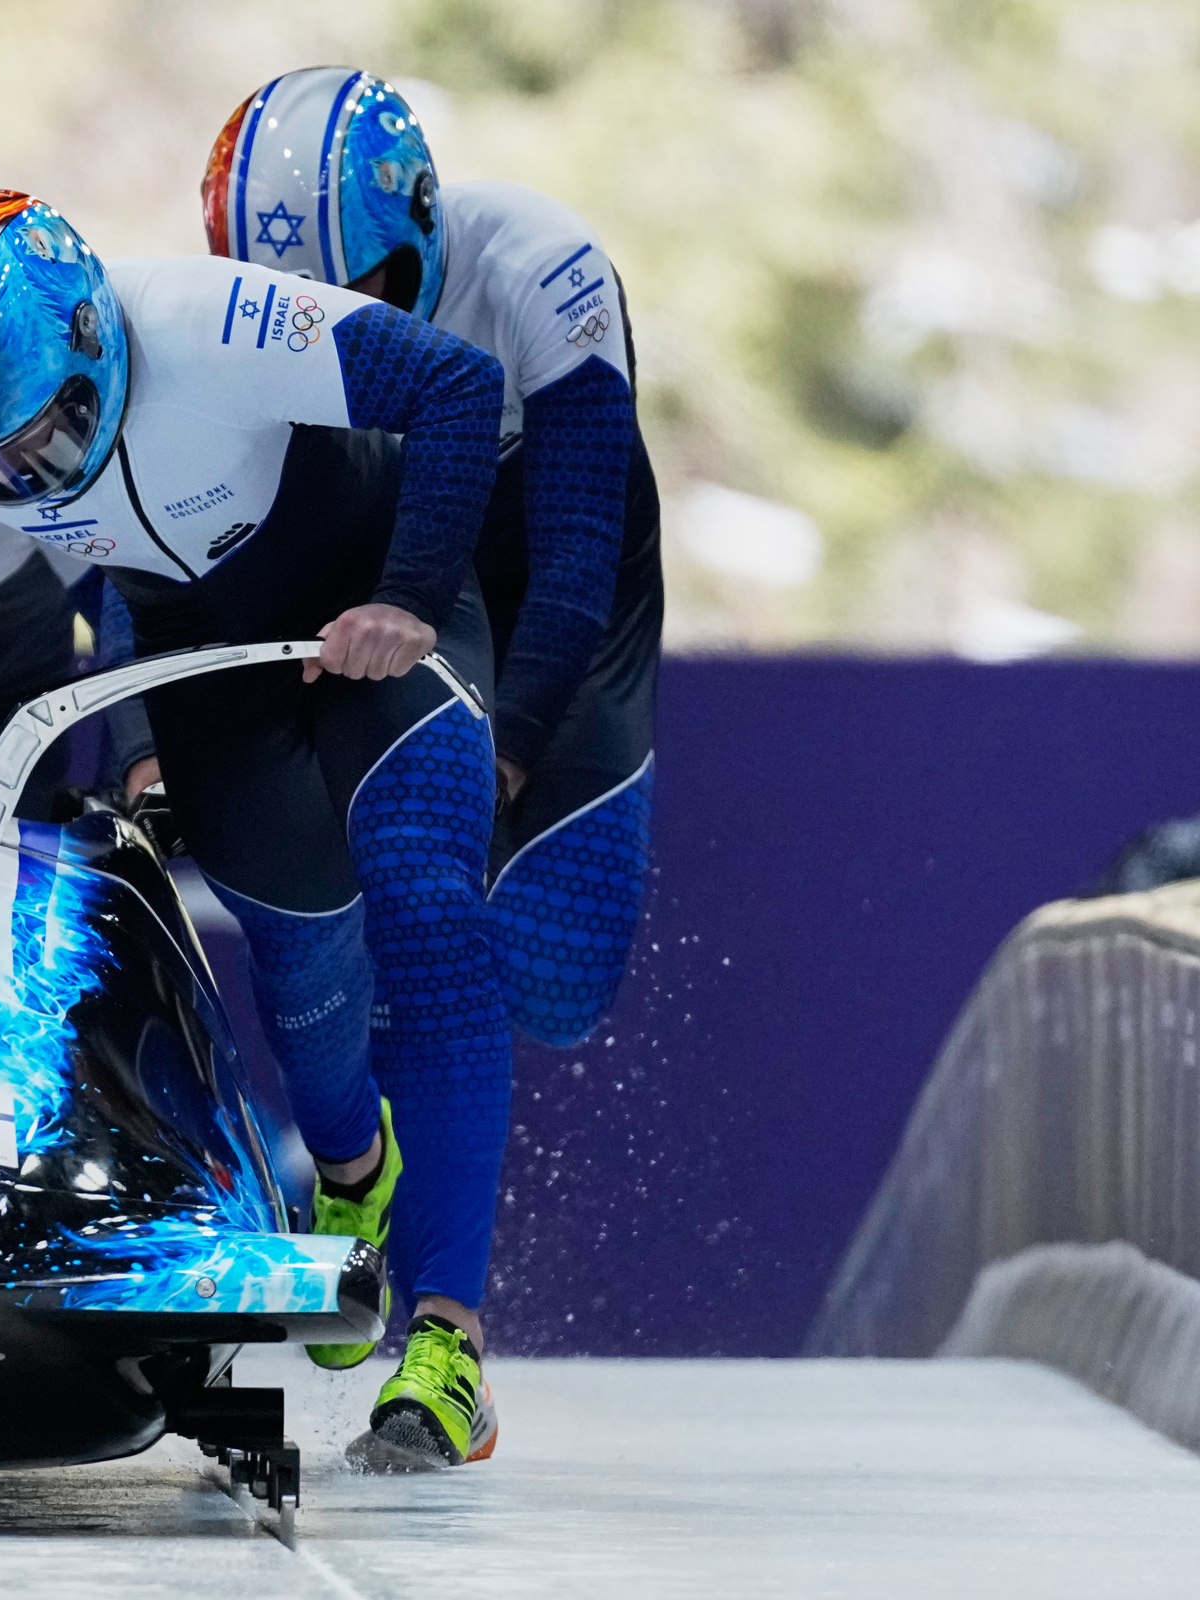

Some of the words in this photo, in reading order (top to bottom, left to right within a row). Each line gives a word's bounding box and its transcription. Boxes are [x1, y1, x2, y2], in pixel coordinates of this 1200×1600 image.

[271, 296, 290, 340] ISRAEL
[567, 294, 603, 322] ISRAEL
[164, 495, 202, 512] NINETY
[206, 483, 227, 498] ONE
[170, 490, 235, 519] COLLECTIVE
